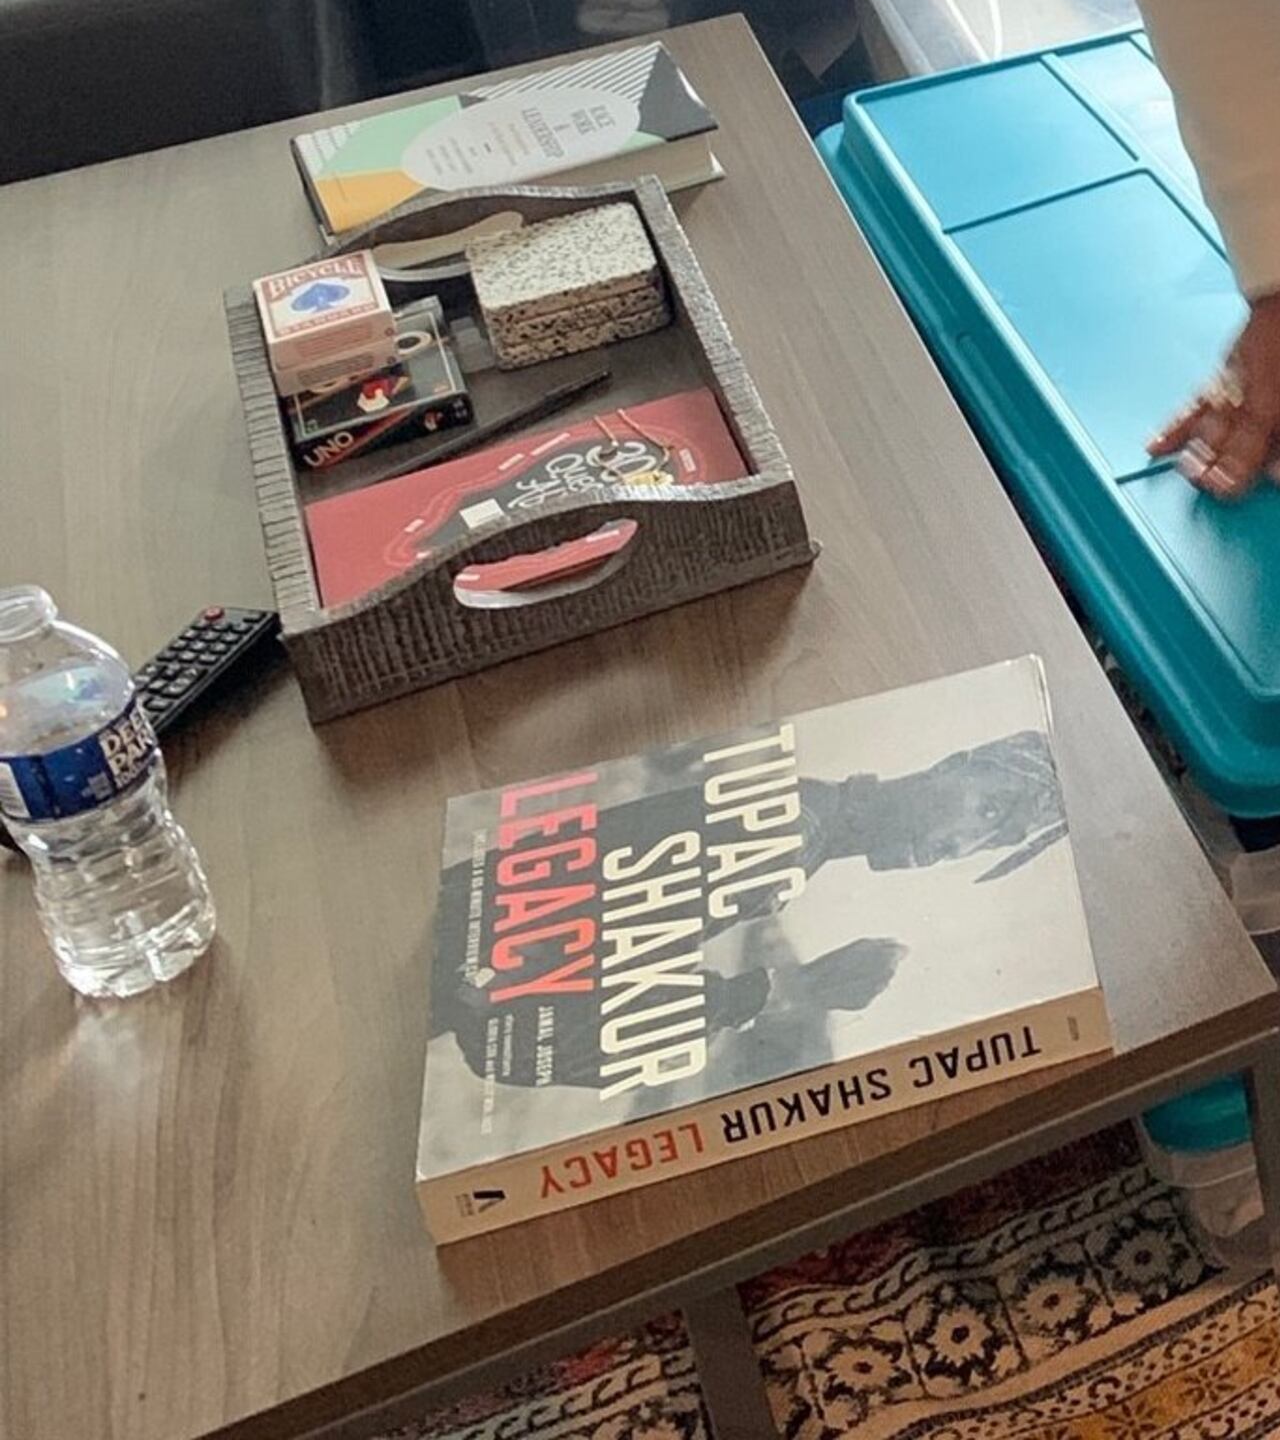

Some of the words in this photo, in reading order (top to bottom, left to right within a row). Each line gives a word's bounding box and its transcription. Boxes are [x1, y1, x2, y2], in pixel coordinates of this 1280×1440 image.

[303, 430, 354, 468] UNO
[703, 723, 807, 919] TUPAC
[489, 770, 599, 1003] LEGACY
[599, 830, 707, 1102] SHAKUR
[535, 1044, 553, 1087] JOSEPH
[911, 1024, 1044, 1089] TUPAC
[720, 1067, 893, 1145] SHAKUR
[539, 1122, 705, 1200] LEGACY
